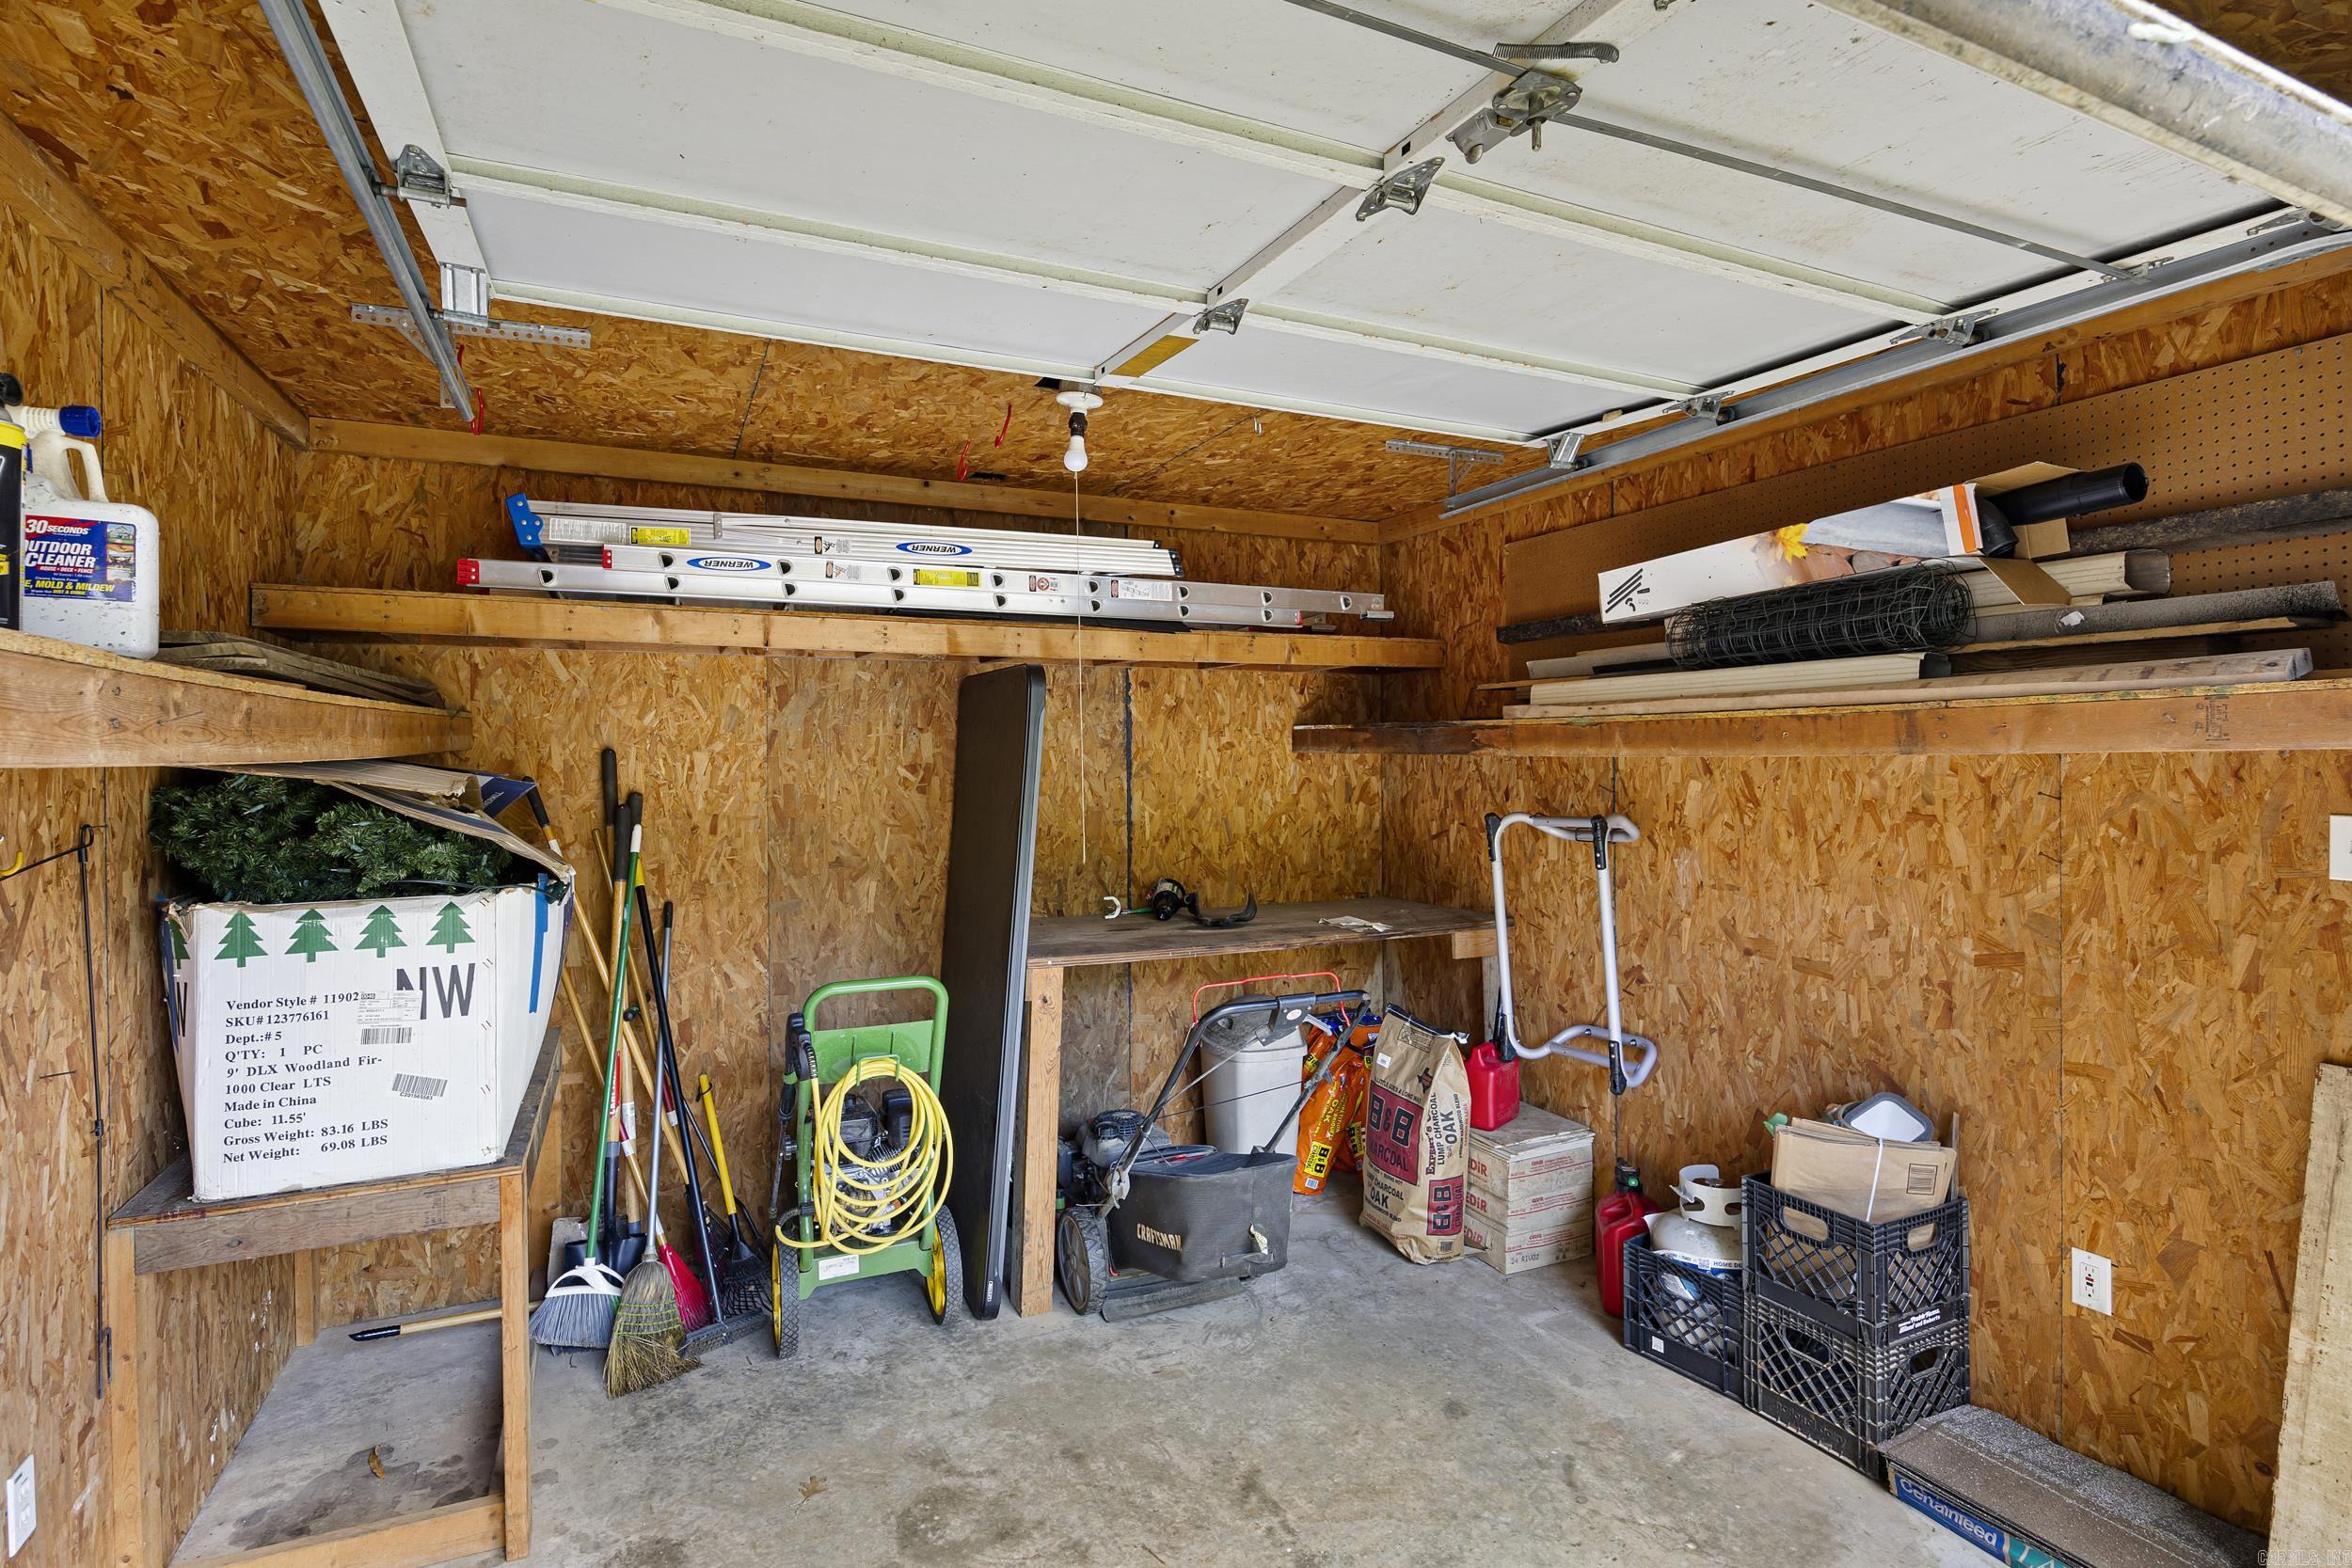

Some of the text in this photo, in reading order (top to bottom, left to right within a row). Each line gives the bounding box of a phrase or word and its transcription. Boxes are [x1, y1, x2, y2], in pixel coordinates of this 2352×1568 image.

[25, 519, 89, 535] 30 SECONDS
[912, 544, 957, 553] WERNER
[24, 552, 96, 568] CLEANER
[704, 559, 755, 569] WERNER
[36, 580, 63, 590] MOLD
[66, 581, 73, 590] &
[75, 582, 115, 593] MILDEW
[227, 991, 359, 1010] Vendor Style # 11902
[226, 1010, 329, 1028] SKU# 123776161
[275, 1031, 282, 1041] 5
[225, 1044, 323, 1063] Q'TY: 1 PC
[227, 1055, 382, 1078] 9' DLX Woodland Fir-
[225, 1076, 331, 1095] 1000 Clear LTS
[224, 1096, 317, 1112] Made in China
[224, 1112, 307, 1130] Cube: 11.55'
[1429, 1093, 1445, 1165] LUMP CHARCOAL
[1439, 1110, 1457, 1145] OAK
[224, 1118, 389, 1147] Gross Weight: 83.16 LBS
[223, 1135, 388, 1164] Net Weight: 69.08 LBS
[1370, 1187, 1389, 1209] OAK
[1375, 1179, 1404, 1201] CHARCOAL
[1432, 1185, 1453, 1230] B&B
[1454, 1184, 1463, 1227] CHARCOAL
[1136, 1223, 1183, 1252] CRAFTSMAN
